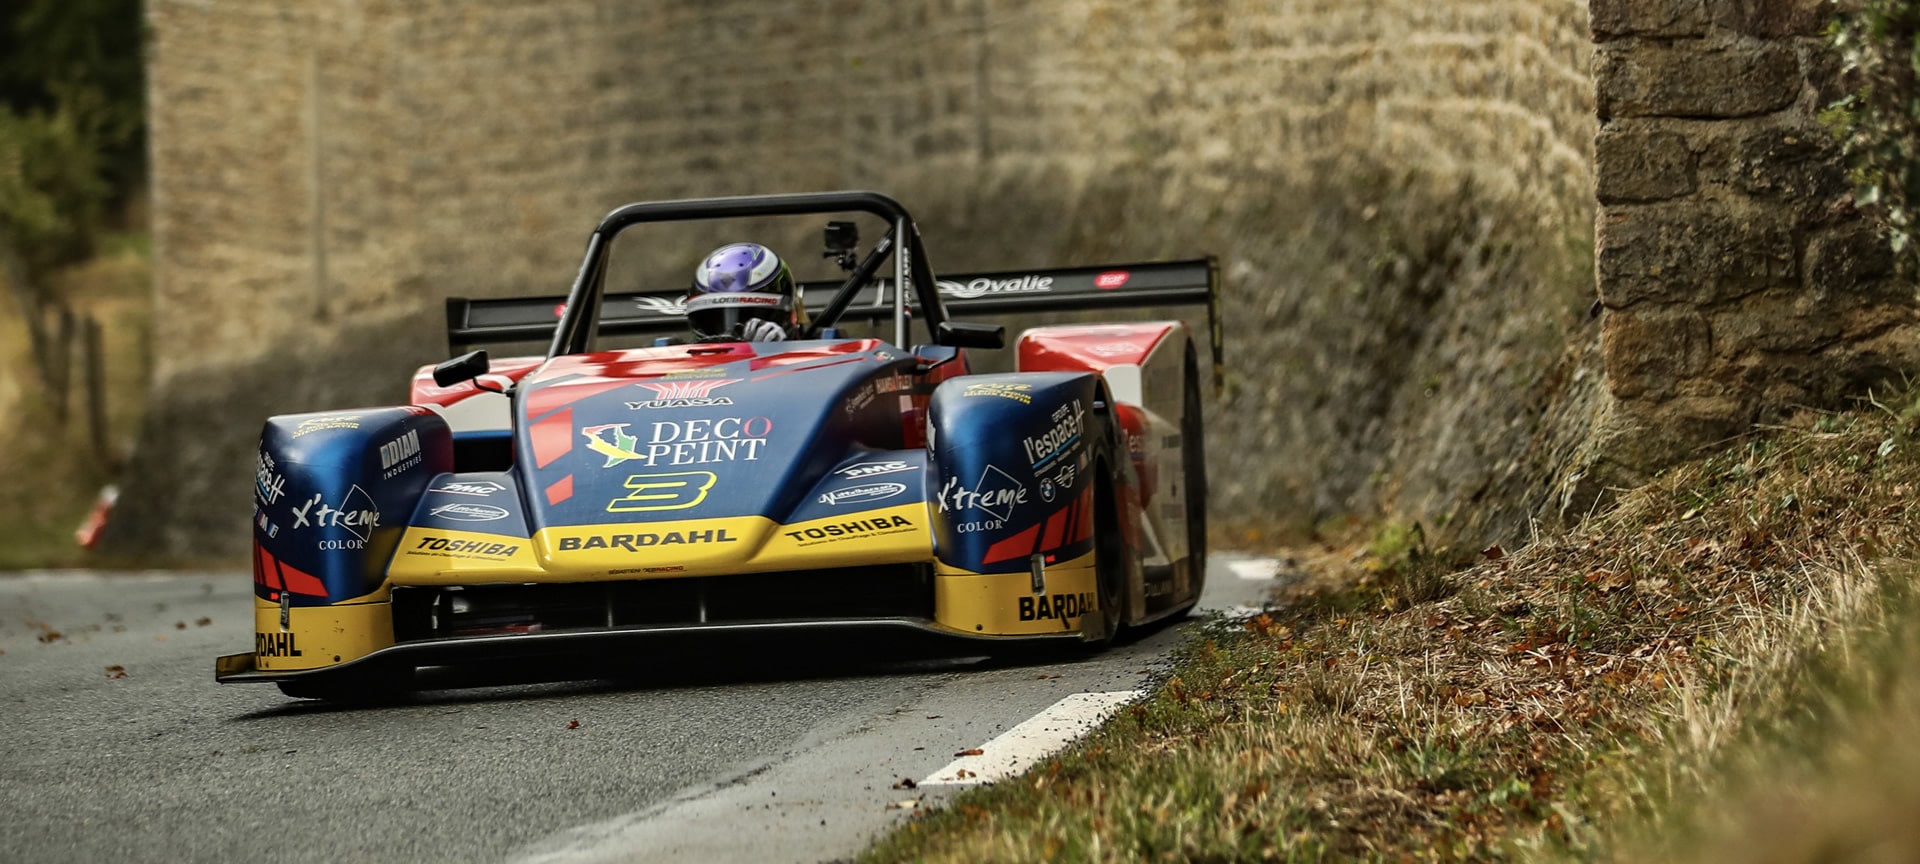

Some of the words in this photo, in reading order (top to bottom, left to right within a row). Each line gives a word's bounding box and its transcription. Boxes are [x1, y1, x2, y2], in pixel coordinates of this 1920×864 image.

[967, 275, 1054, 295] Ovalie
[624, 395, 734, 410] YUASA
[649, 416, 773, 444] DECO
[643, 438, 767, 467] PEINT
[383, 452, 422, 480] INDUSTRIES
[844, 462, 908, 476] PMC
[440, 483, 498, 494] PMC
[606, 471, 718, 513] 3
[936, 476, 1030, 514] X'treme
[292, 493, 382, 530] X'treme
[785, 515, 913, 542] TOSHIBA
[956, 519, 1004, 534] COLOR
[318, 539, 364, 551] COLOR
[417, 537, 520, 557] TOSHIBA
[558, 529, 738, 552] BARDAHL
[1018, 592, 1098, 630] BARDAH
